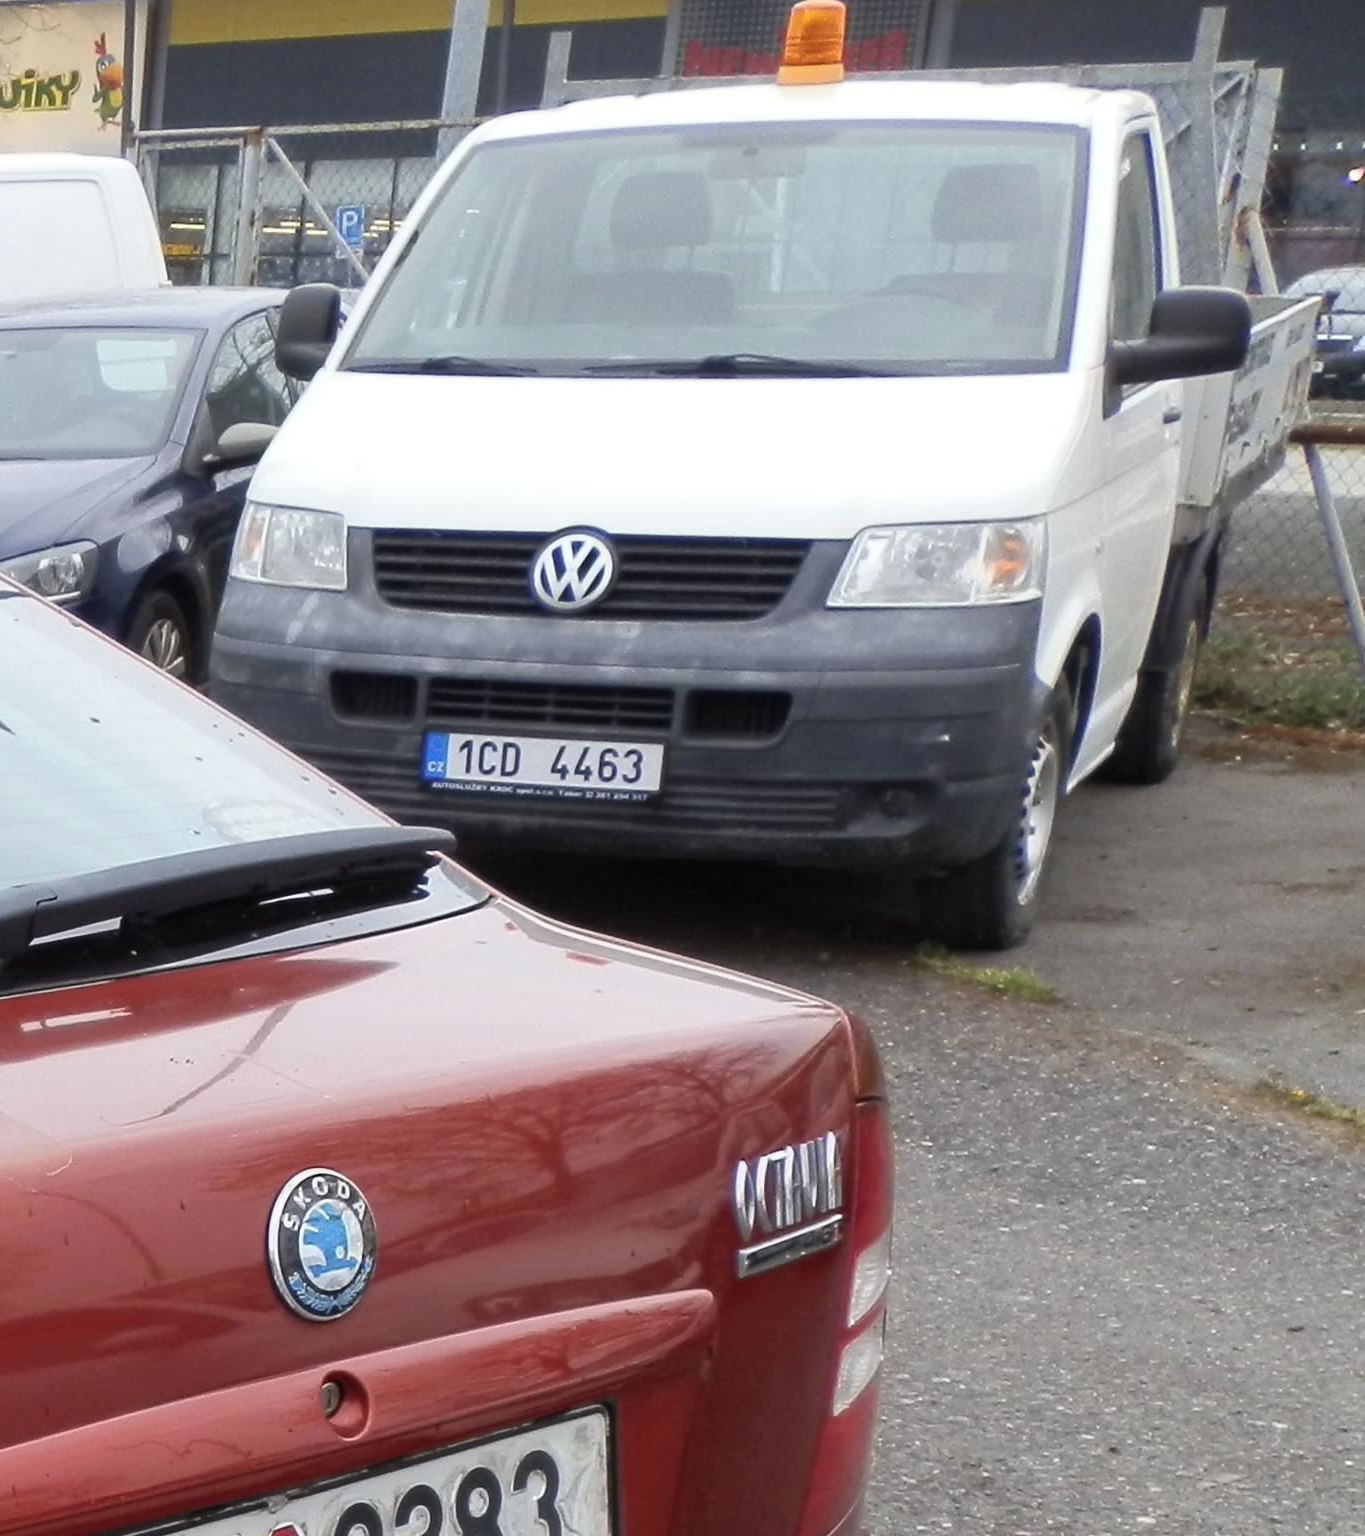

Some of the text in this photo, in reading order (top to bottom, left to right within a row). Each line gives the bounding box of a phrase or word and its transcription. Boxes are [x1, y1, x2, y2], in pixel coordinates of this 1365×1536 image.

[341, 211, 358, 238] P
[427, 761, 445, 773] CZ
[459, 739, 644, 784] 1CD 4463
